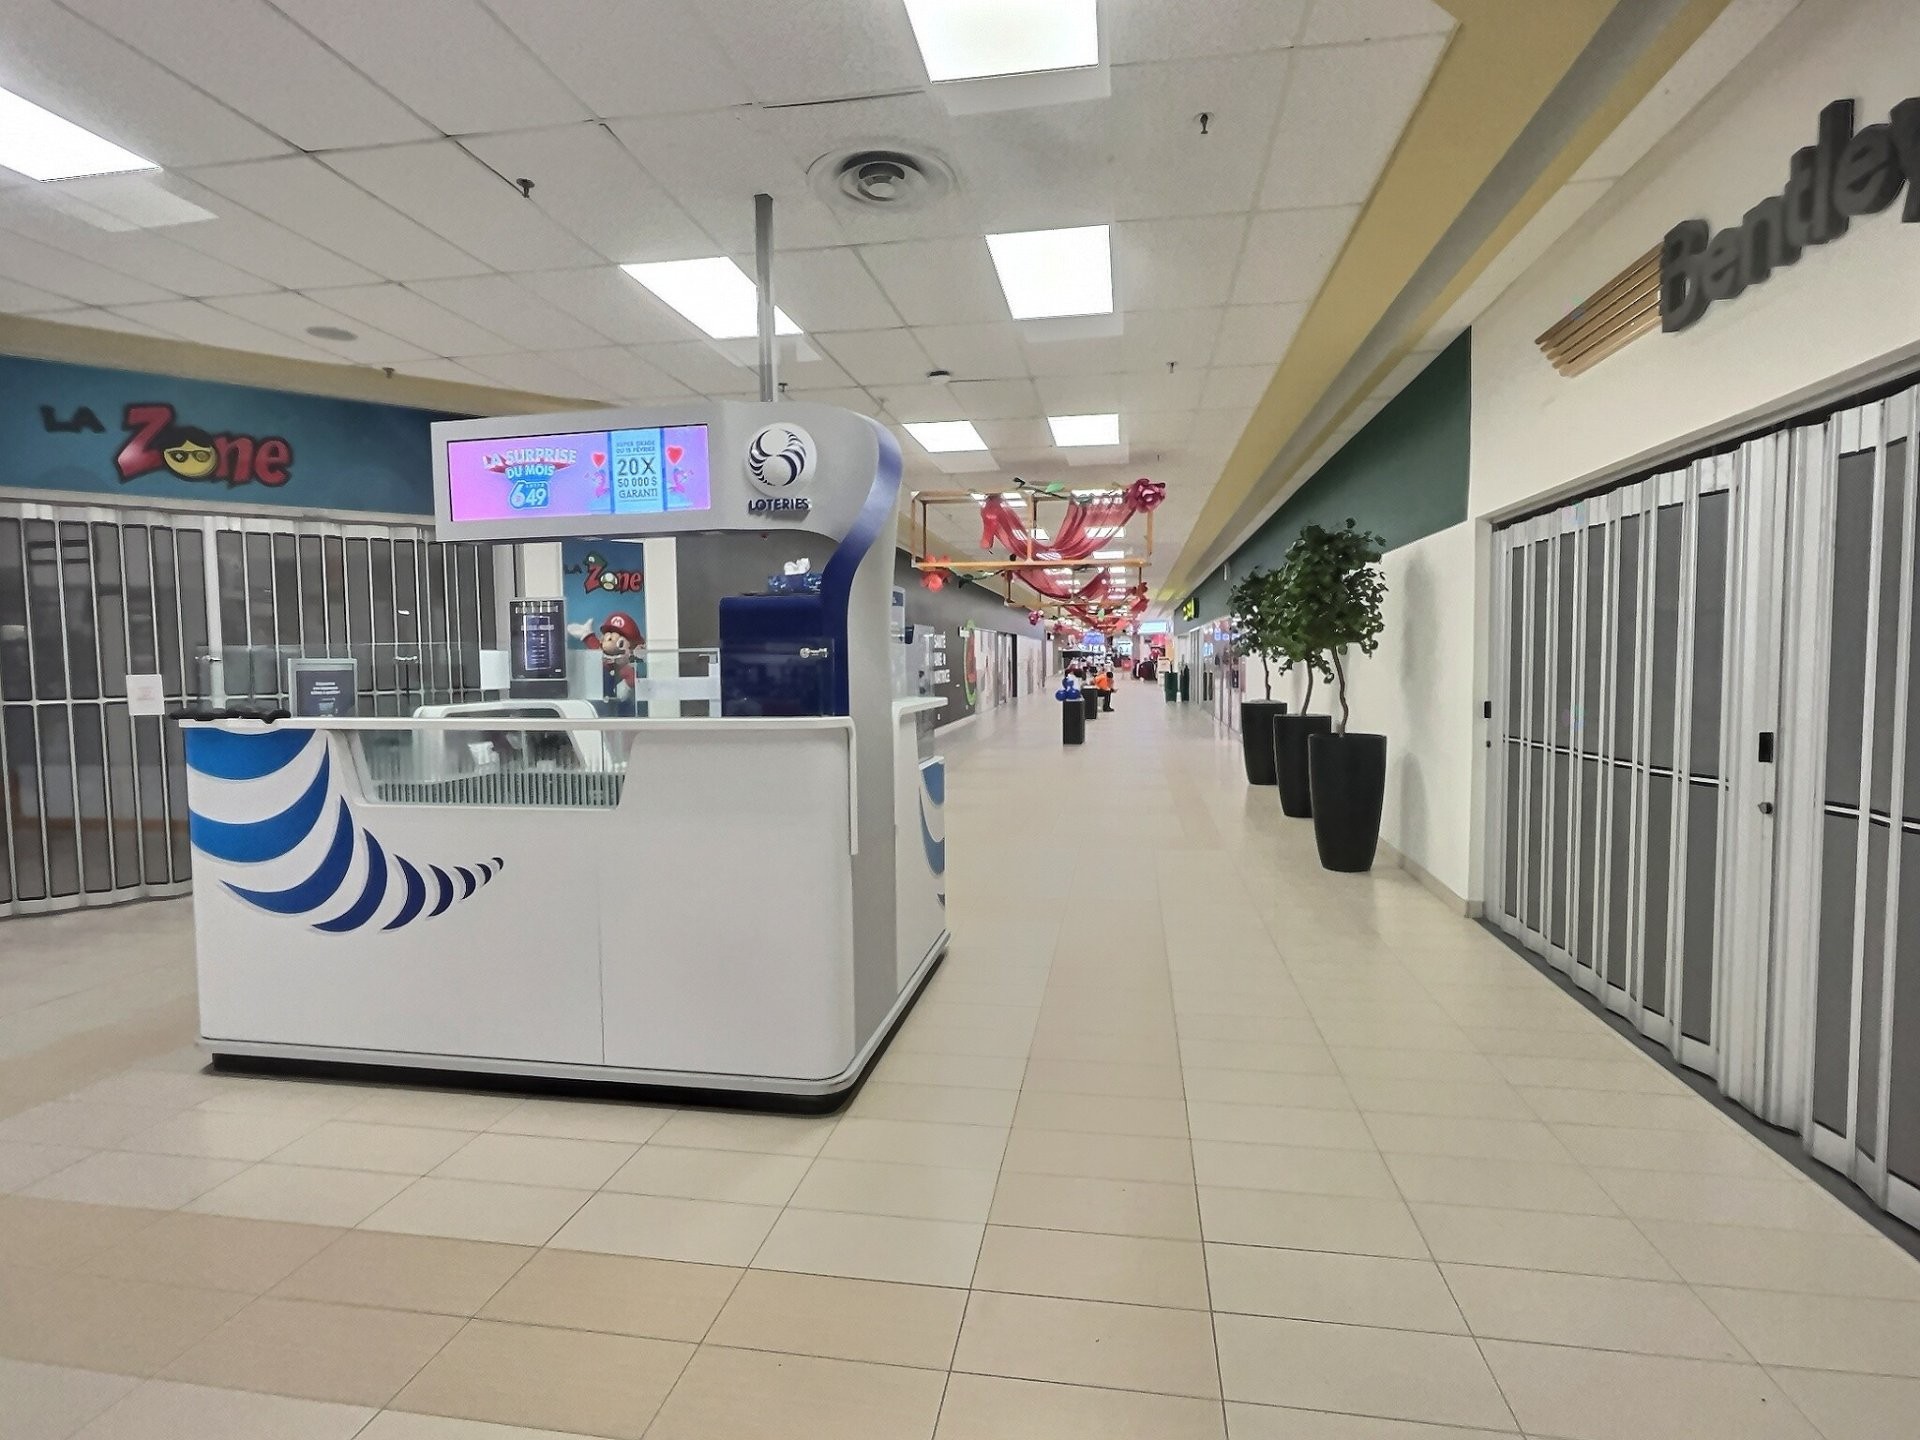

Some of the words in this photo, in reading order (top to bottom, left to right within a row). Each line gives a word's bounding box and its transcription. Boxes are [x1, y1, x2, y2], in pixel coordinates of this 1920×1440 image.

[40, 405, 106, 433] LA
[482, 453, 504, 469] LA
[505, 447, 577, 465] SURPRISE
[505, 466, 523, 479] DU
[524, 463, 555, 477] MOIS
[618, 488, 658, 498] GARANTI
[748, 498, 811, 513] LOTERIES
